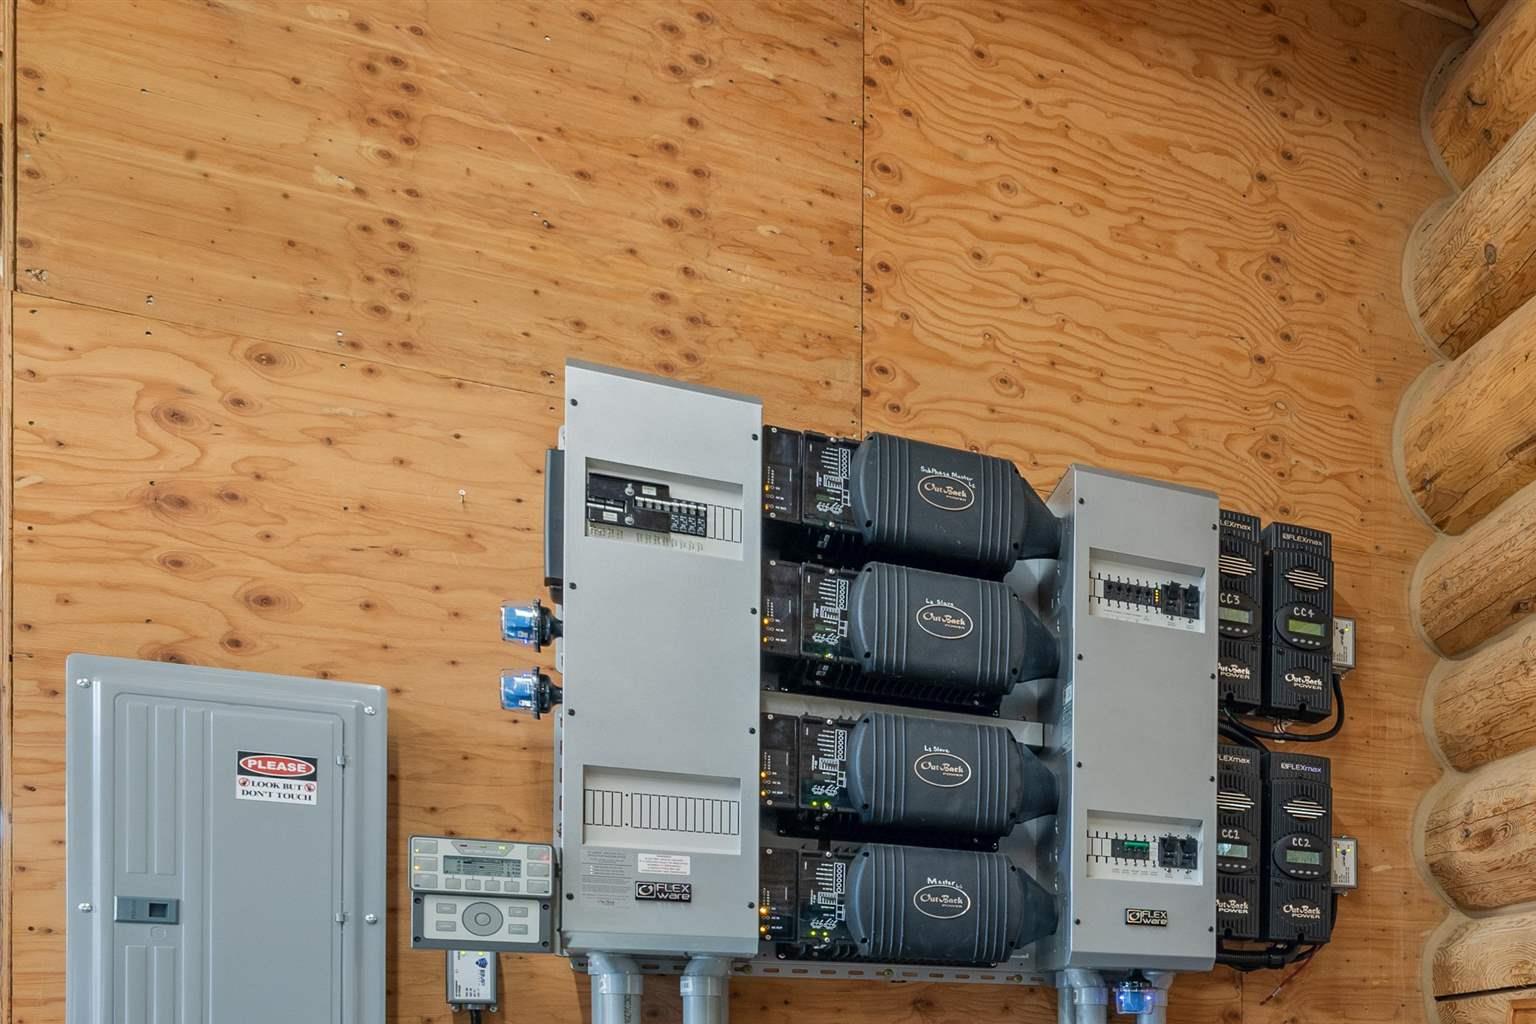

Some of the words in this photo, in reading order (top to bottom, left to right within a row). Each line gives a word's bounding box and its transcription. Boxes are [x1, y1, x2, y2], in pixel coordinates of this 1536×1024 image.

[1220, 520, 1252, 531] LEXmax
[1219, 592, 1240, 605] CC3
[1293, 607, 1315, 618] CC4
[1285, 673, 1323, 686] OutBack
[1218, 754, 1251, 764] LEXmax
[247, 759, 307, 772] PLEASE
[1287, 763, 1322, 773] FLEXmax
[251, 781, 280, 789] LOOK
[283, 783, 302, 791] BUT
[241, 789, 272, 798] DON'T
[277, 792, 312, 801] TOUCH
[1292, 837, 1311, 848] CC2
[656, 883, 690, 893] FLEX
[656, 892, 690, 900] ware
[1142, 910, 1167, 919] FLEX
[1283, 904, 1321, 916] OutBack
[1142, 918, 1168, 926] ware
